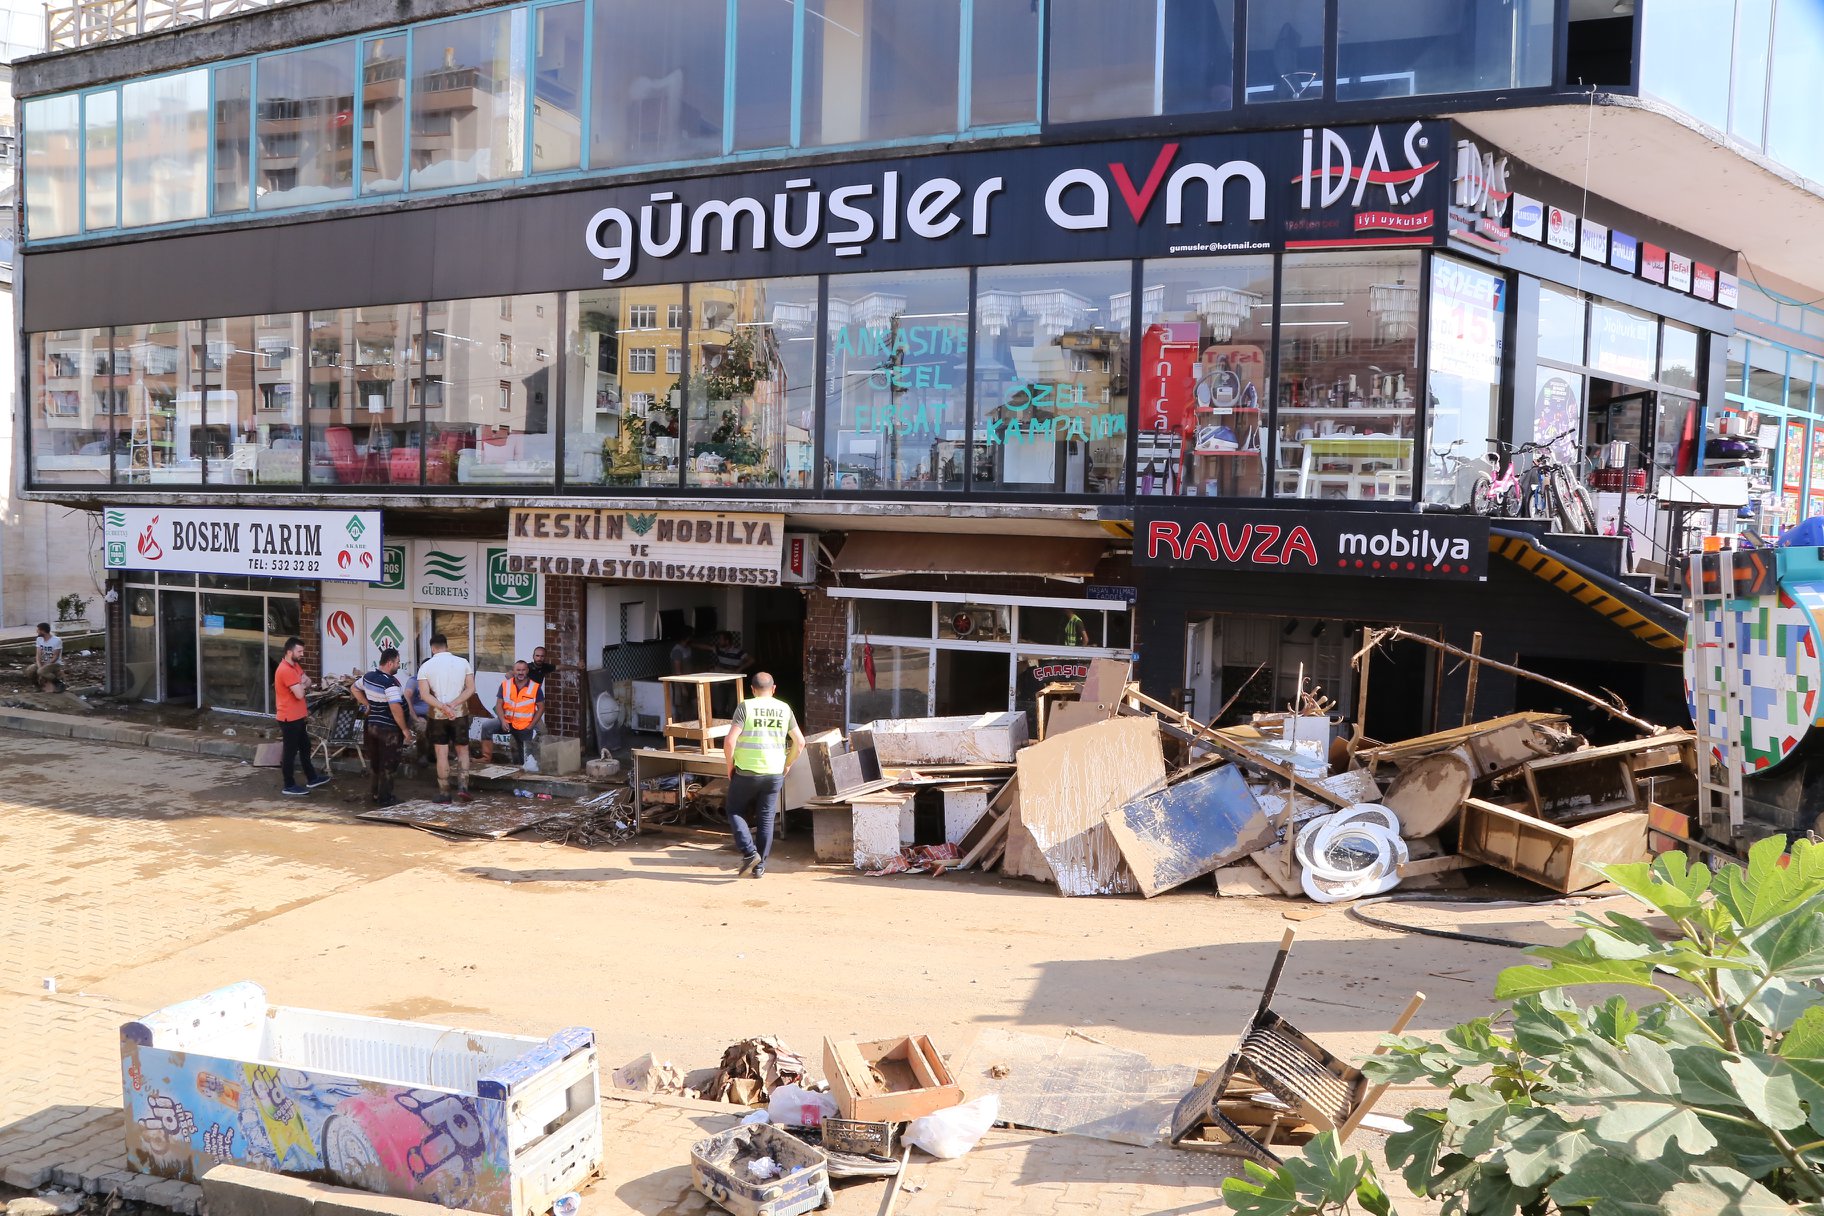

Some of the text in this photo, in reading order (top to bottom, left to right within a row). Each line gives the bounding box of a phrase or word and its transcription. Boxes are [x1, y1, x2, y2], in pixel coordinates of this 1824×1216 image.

[1045, 143, 1266, 230] avm
[1358, 213, 1428, 226] iyi uykular
[1169, 240, 1271, 254] gumusler@hotmail.com
[1562, 238, 1575, 249] Good
[1582, 227, 1606, 254] PHILIPS
[1671, 260, 1690, 275] Tefal
[868, 361, 953, 391] ÖZEL
[1004, 376, 1099, 411] ÖZEL
[855, 403, 949, 437] FIRSAT
[986, 412, 1127, 446] KAMPANYA
[172, 521, 322, 556] BOSEM TARIM
[514, 510, 774, 546] KESKİN MOBİLYA
[630, 544, 650, 558] VE
[793, 542, 801, 568] VESTEL
[1147, 520, 1470, 567] RAVZA mobilya
[249, 558, 320, 572] TEL: 532 32 82
[384, 563, 400, 574] ROS
[509, 555, 779, 585] DEKORASYON 05448085553
[421, 583, 469, 600] GÜBRETAŞ
[494, 573, 530, 587] TOROS
[1088, 586, 1136, 596] HASAN YILMAZ
